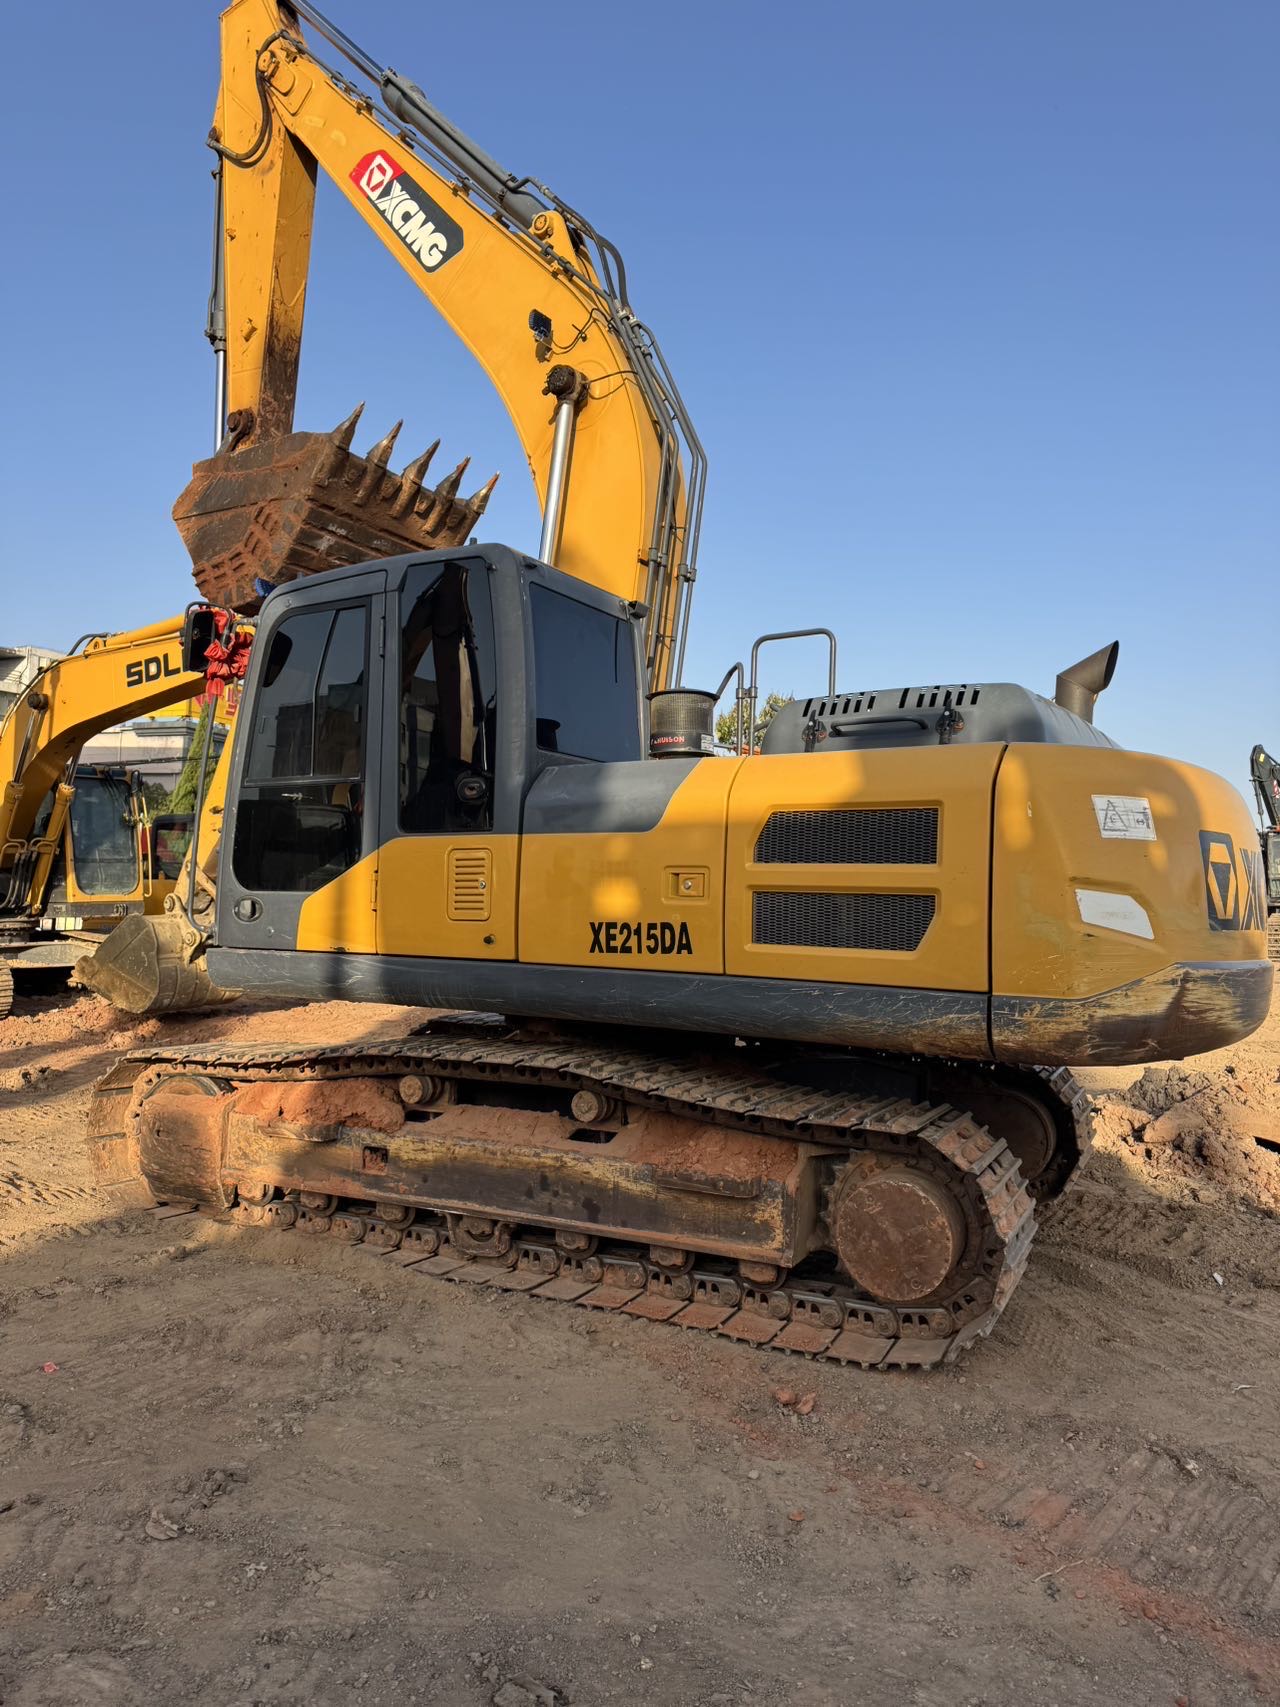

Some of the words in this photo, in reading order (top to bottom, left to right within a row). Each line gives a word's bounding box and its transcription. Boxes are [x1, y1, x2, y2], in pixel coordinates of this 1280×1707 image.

[375, 179, 448, 268] XCMG
[126, 648, 185, 687] SDL
[589, 921, 693, 955] XE215DA
